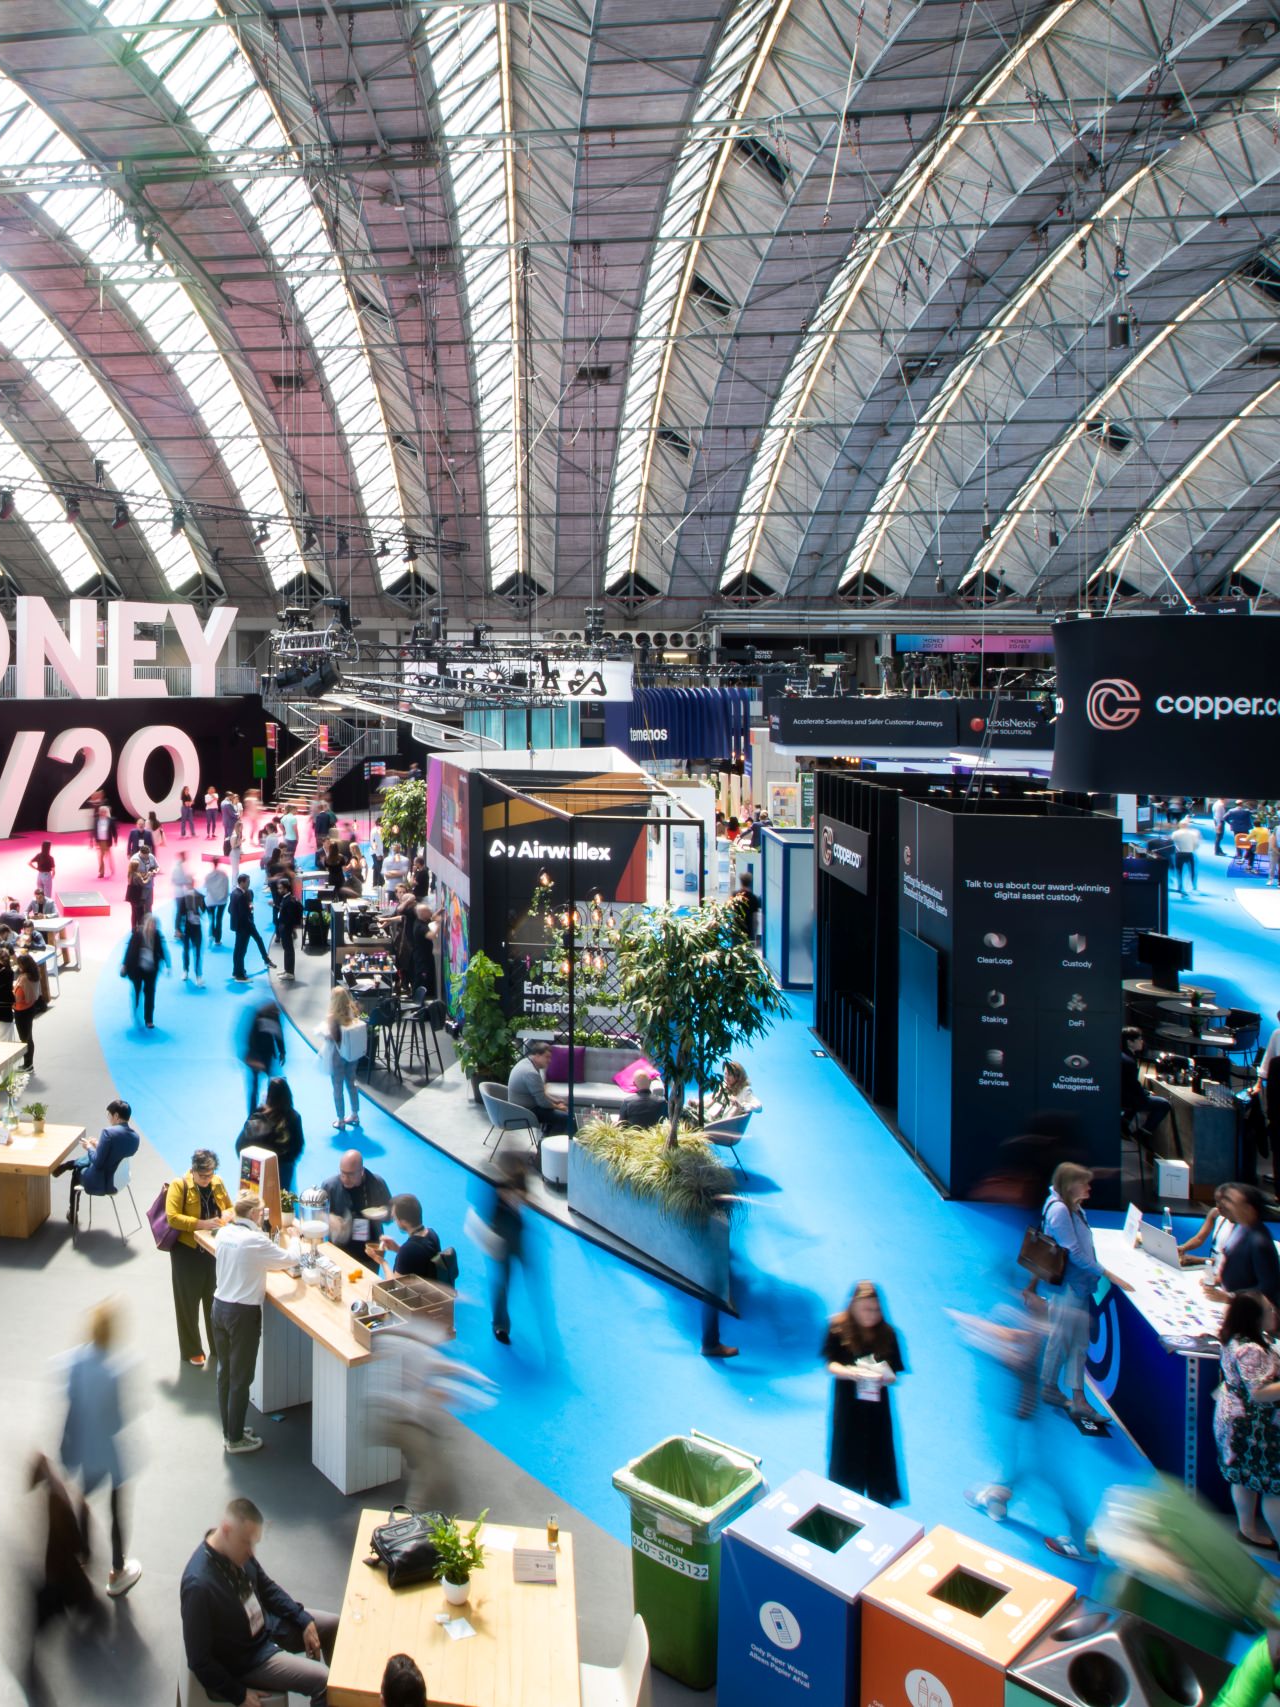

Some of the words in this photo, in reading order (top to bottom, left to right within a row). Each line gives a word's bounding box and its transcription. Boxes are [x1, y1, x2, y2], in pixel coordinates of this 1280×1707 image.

[1155, 695, 1280, 720] copper.c
[916, 720, 943, 728] Journeys
[986, 718, 1037, 728] LexisNexis
[630, 727, 668, 742] temenos
[965, 880, 982, 888] Talk
[1006, 882, 1030, 890] about
[1047, 884, 1110, 894] award-winning
[994, 892, 1020, 900] digital
[1046, 894, 1083, 902] custody.
[977, 956, 1013, 966] ClearLoop
[1062, 960, 1092, 968] Custody
[982, 1016, 1008, 1024] Staking
[978, 1078, 1009, 1086] Services
[1058, 1076, 1093, 1084] Collateral
[1052, 1083, 1100, 1092] Management
[750, 1642, 766, 1656] Only
[766, 1652, 786, 1667] Paper
[786, 1663, 809, 1680] Waste
[748, 1651, 770, 1666] Alleen
[770, 1662, 791, 1678] Papier
[792, 1674, 810, 1689] Afval
